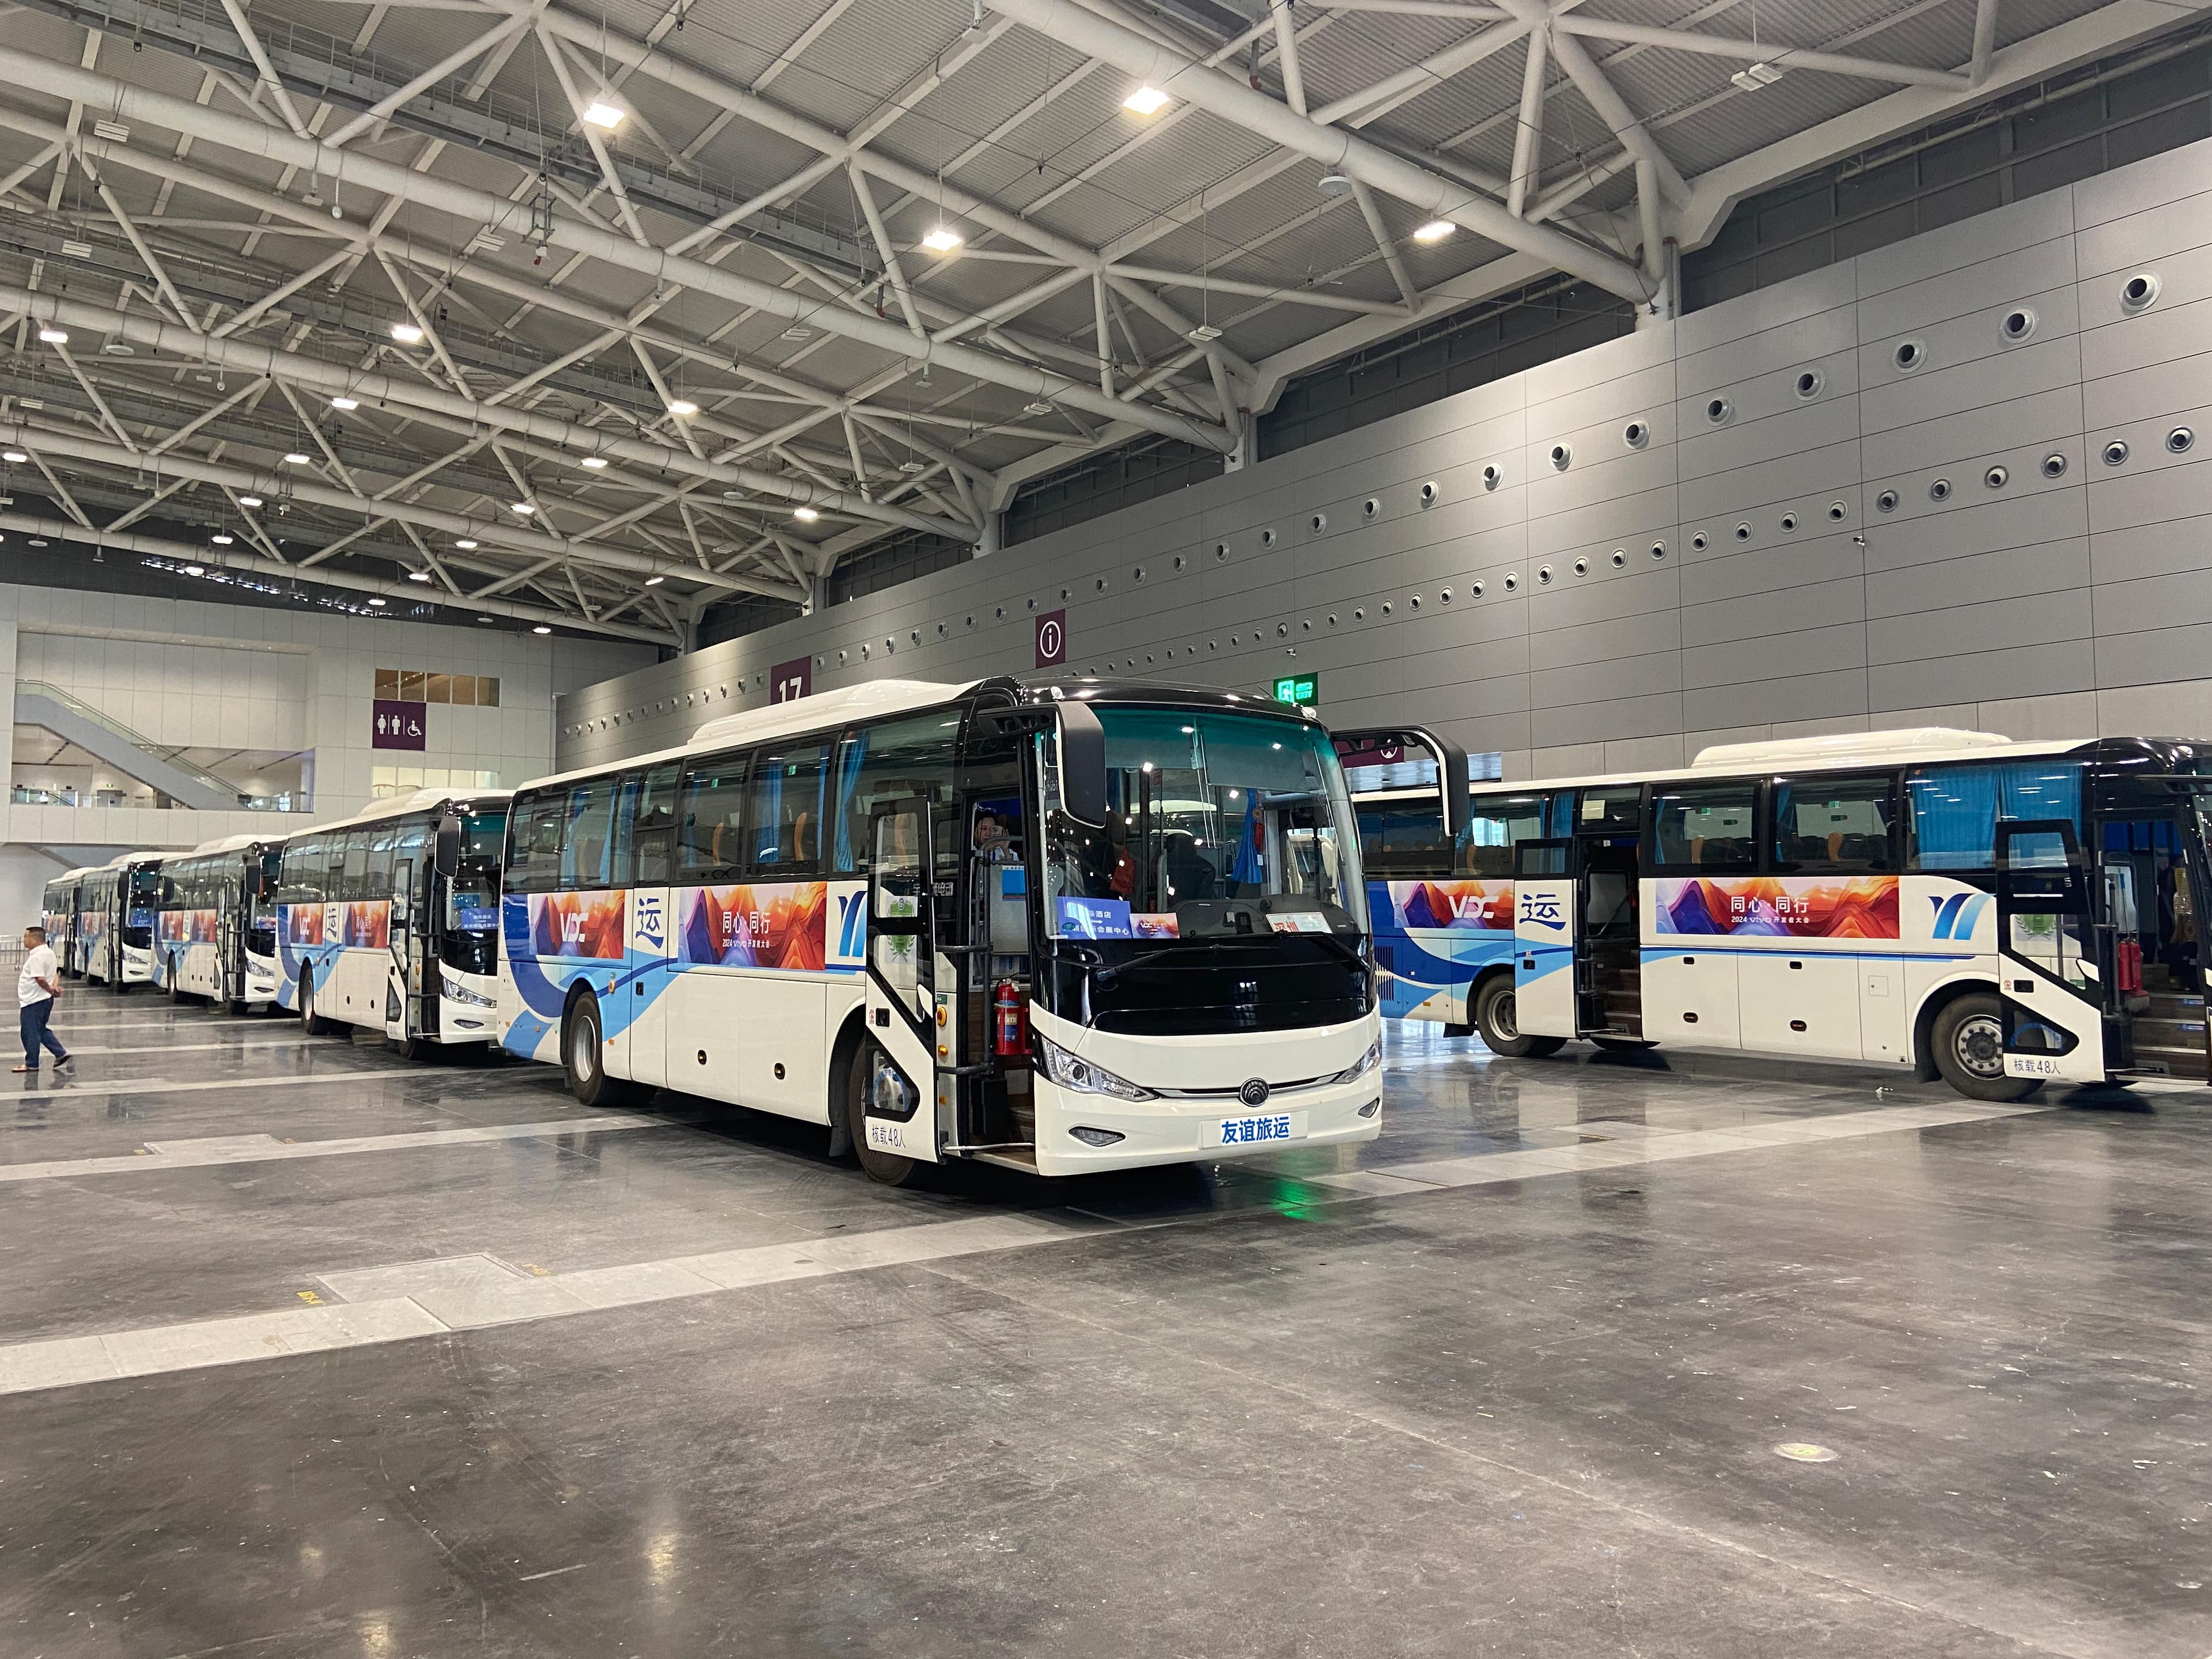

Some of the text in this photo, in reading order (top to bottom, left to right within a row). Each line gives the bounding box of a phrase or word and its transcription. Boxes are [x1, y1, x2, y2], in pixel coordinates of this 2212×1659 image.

[779, 676, 802, 703] 17
[1448, 896, 1499, 919] VDC
[1519, 894, 1566, 930] 运
[560, 912, 589, 942] VDC
[635, 898, 664, 949] 运
[722, 939, 732, 947] 2024
[748, 940, 770, 948] 开发者大会
[1222, 1116, 1290, 1144] 友谊旅运
